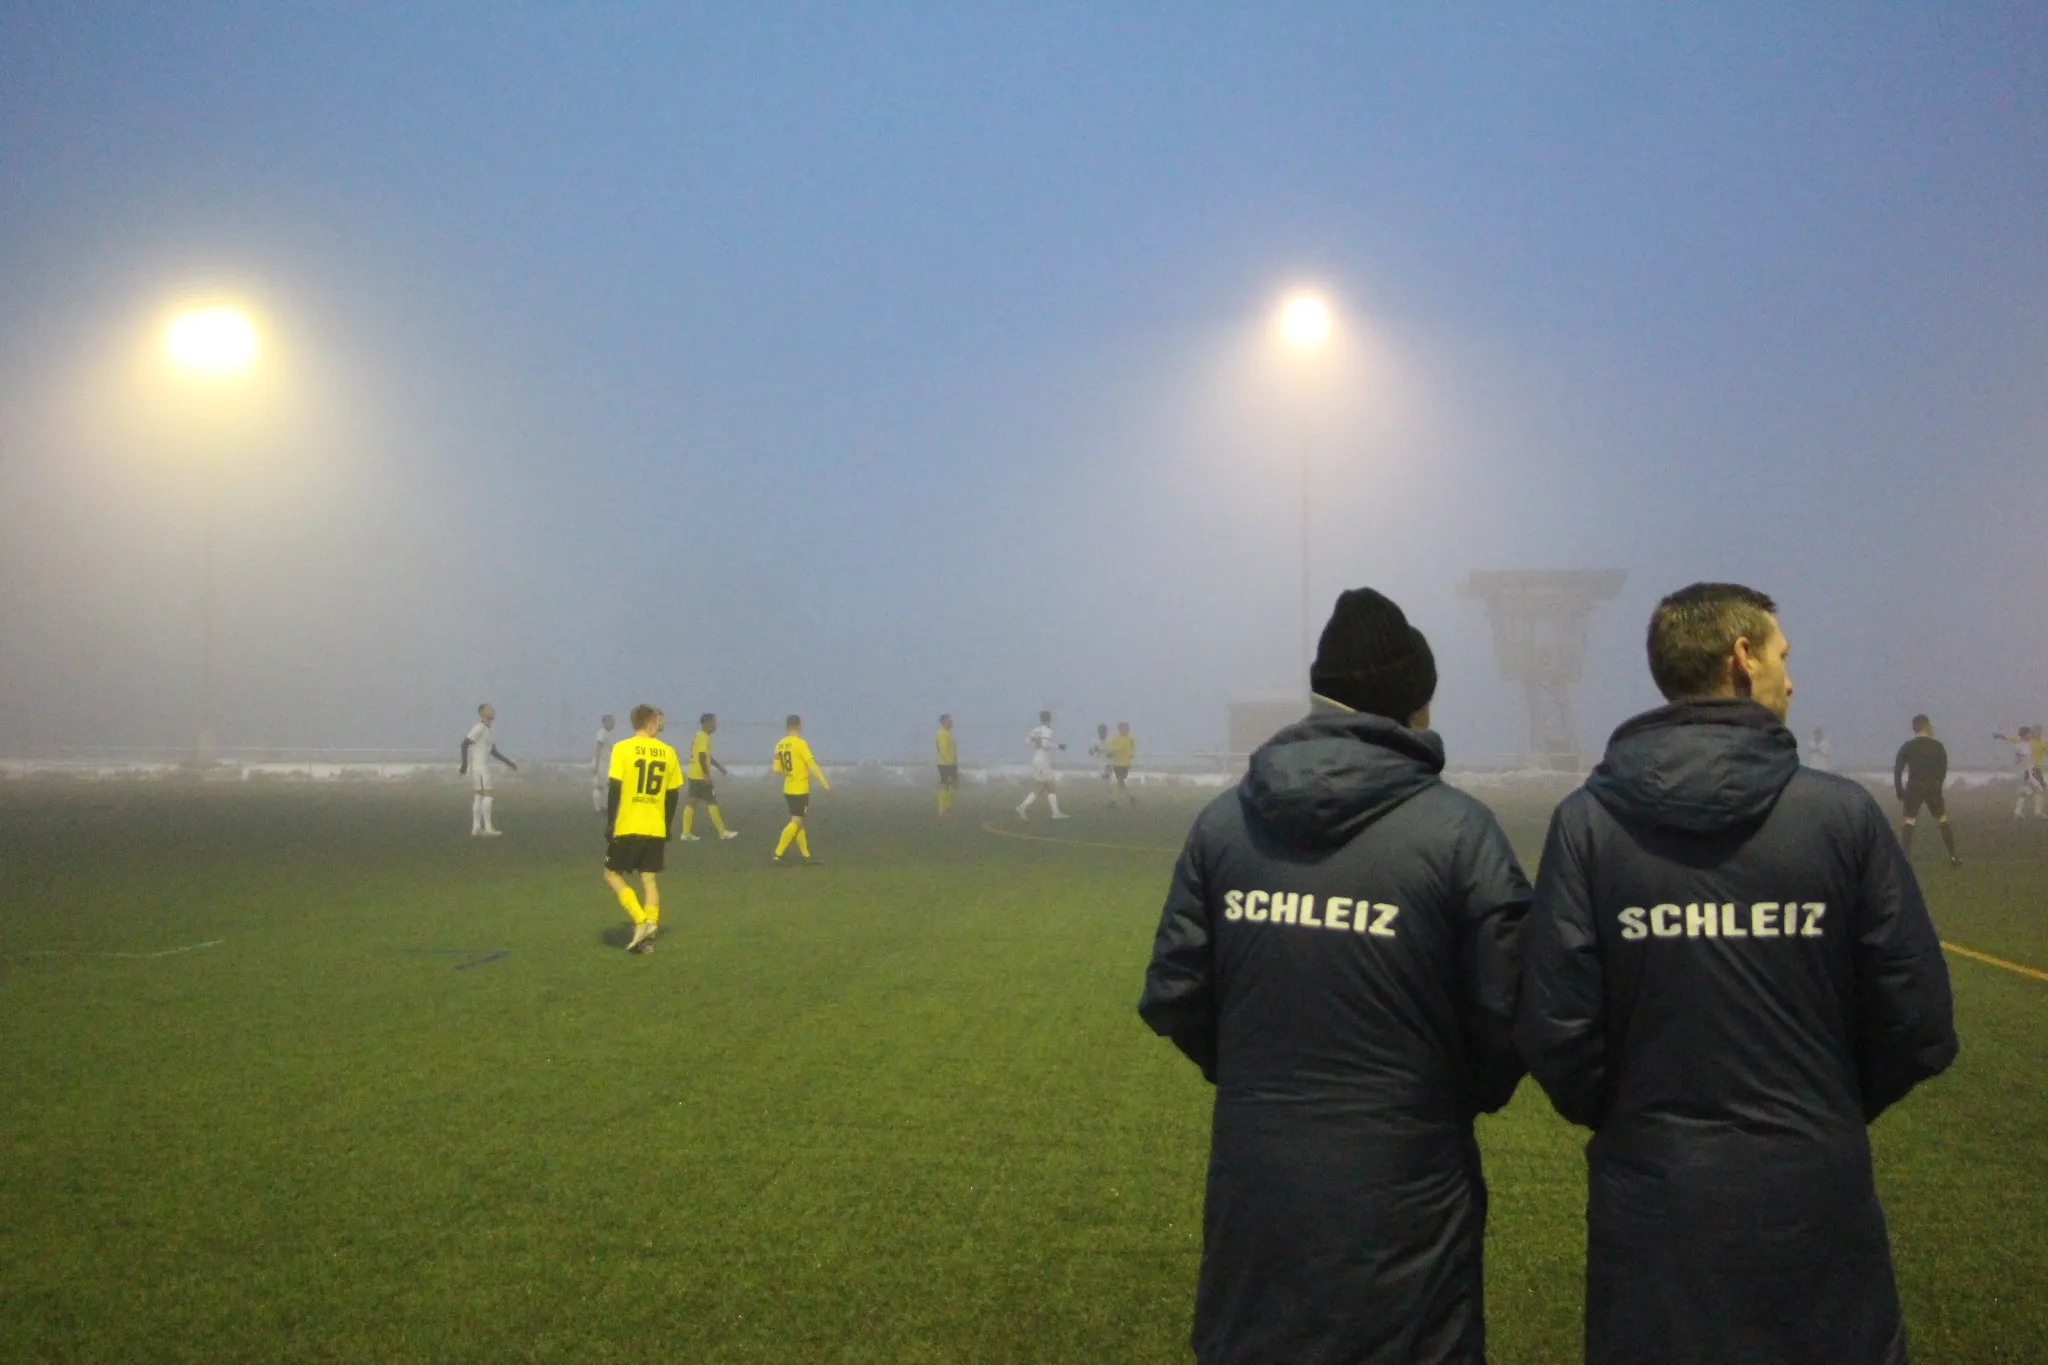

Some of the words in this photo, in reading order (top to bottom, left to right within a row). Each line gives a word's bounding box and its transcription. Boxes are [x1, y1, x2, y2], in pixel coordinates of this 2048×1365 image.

[635, 746, 646, 755] SV
[650, 748, 666, 758] 1911
[634, 758, 667, 795] 16
[1224, 889, 1400, 937] SCHLEIZ
[1617, 902, 1827, 940] SCHLEIZ
